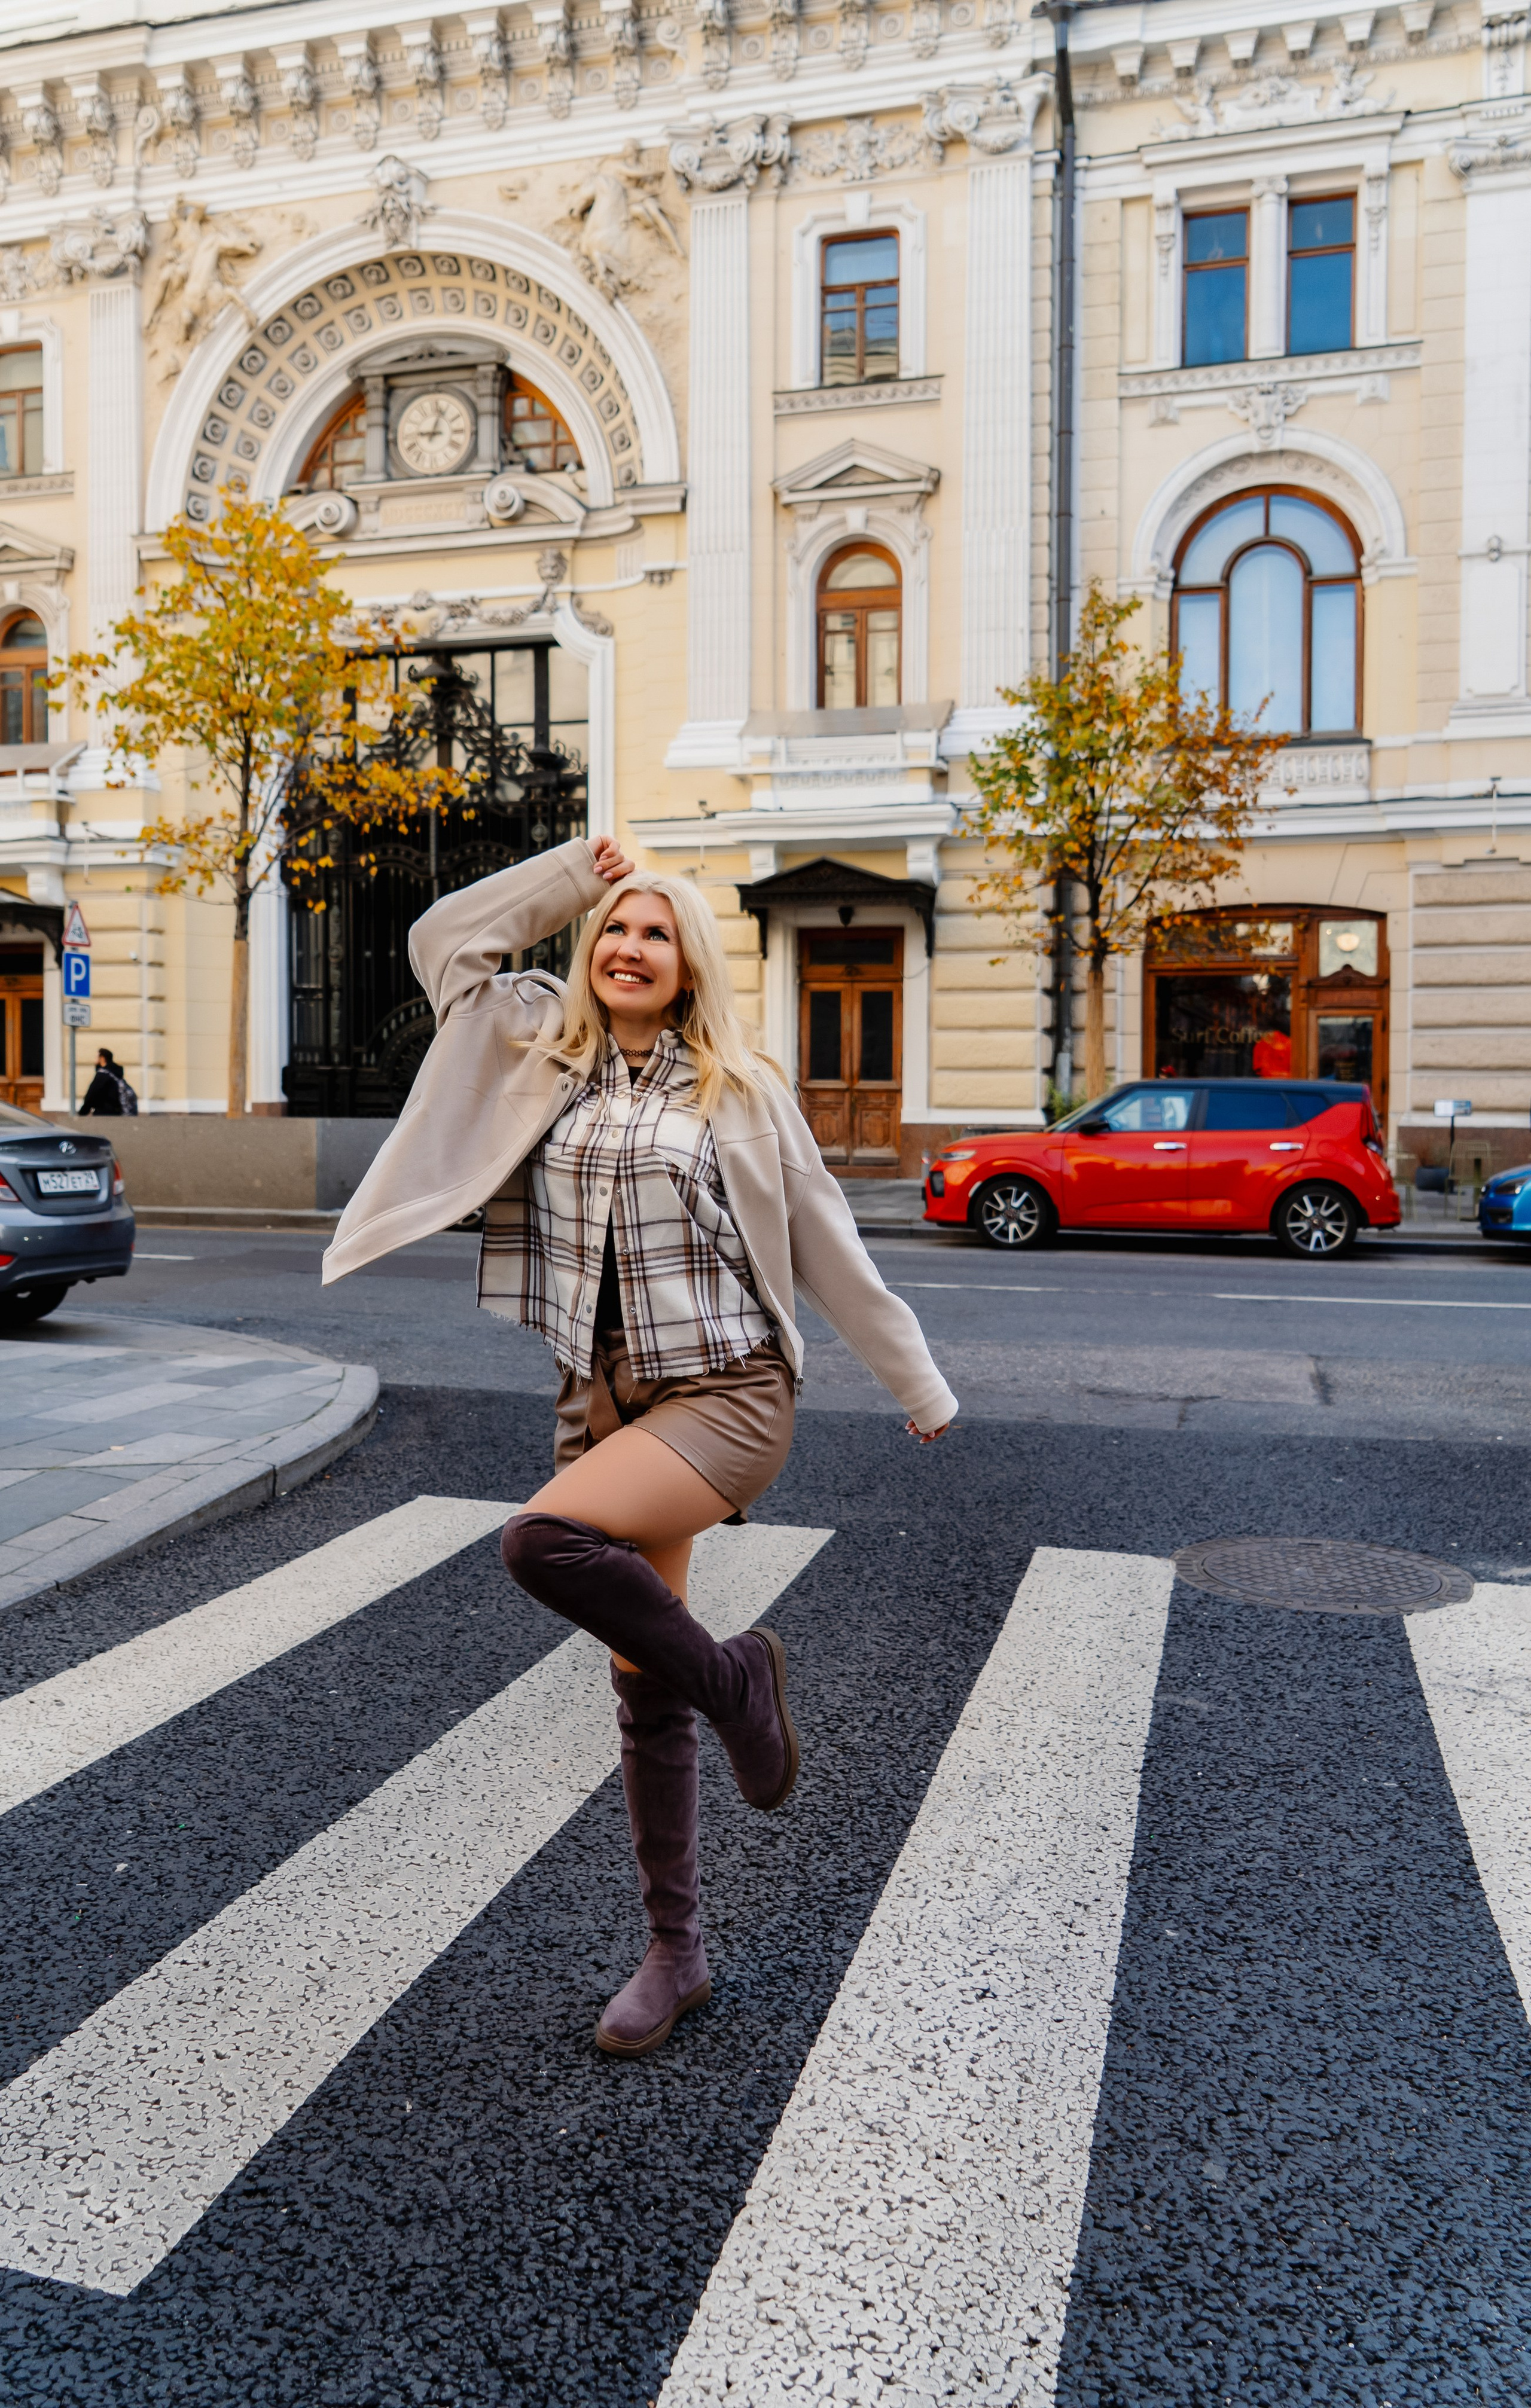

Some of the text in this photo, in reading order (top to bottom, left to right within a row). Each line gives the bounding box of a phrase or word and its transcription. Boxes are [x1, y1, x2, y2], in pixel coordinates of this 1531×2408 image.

[71, 957, 86, 993] P
[1171, 1024, 1274, 1045] Surf Coffee
